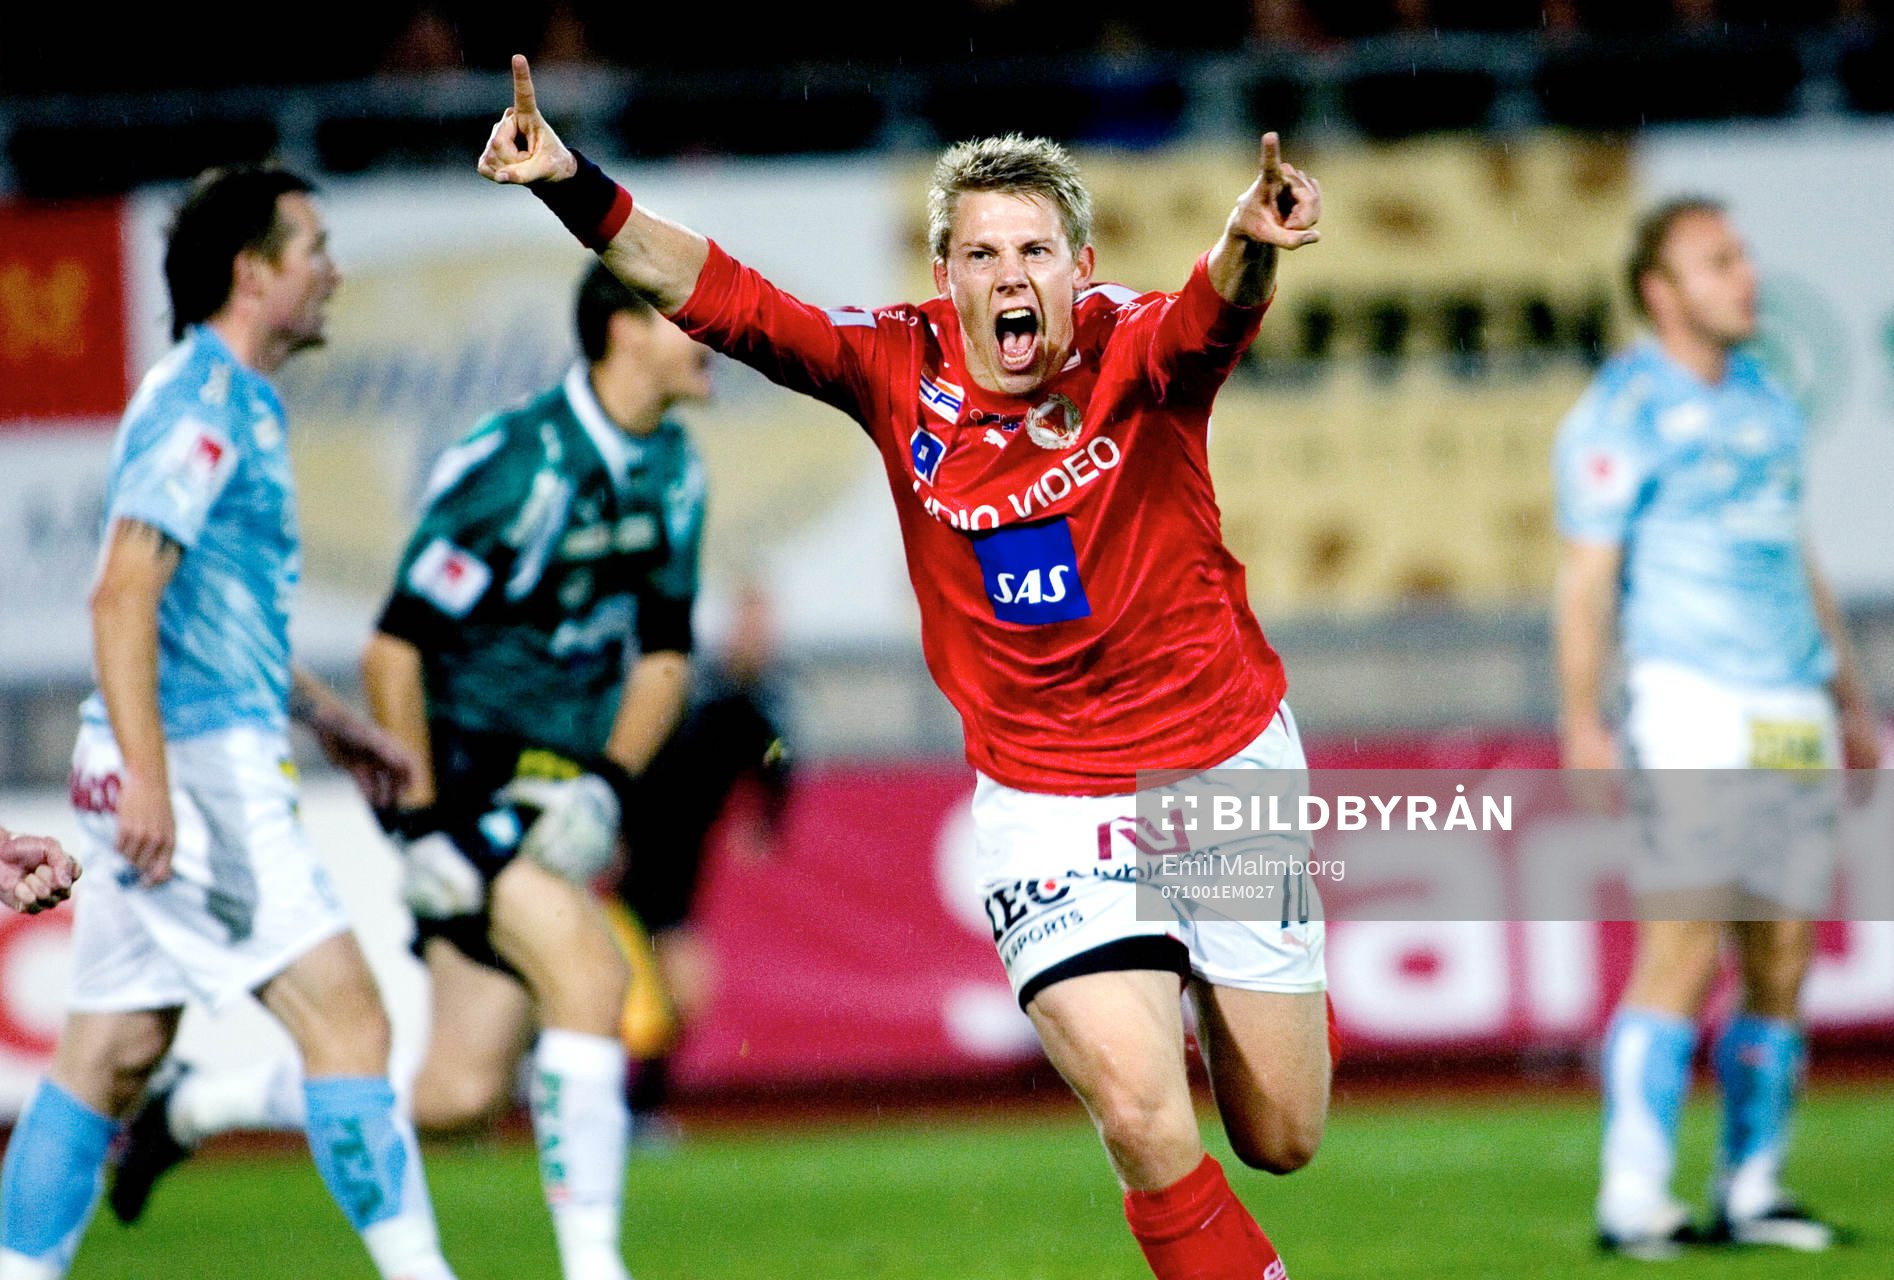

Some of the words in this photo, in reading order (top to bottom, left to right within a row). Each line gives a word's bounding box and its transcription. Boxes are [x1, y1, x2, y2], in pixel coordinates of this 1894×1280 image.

[878, 310, 919, 327] AUDO
[1007, 435, 1121, 518] VIDEO
[993, 564, 1069, 605] SAS
